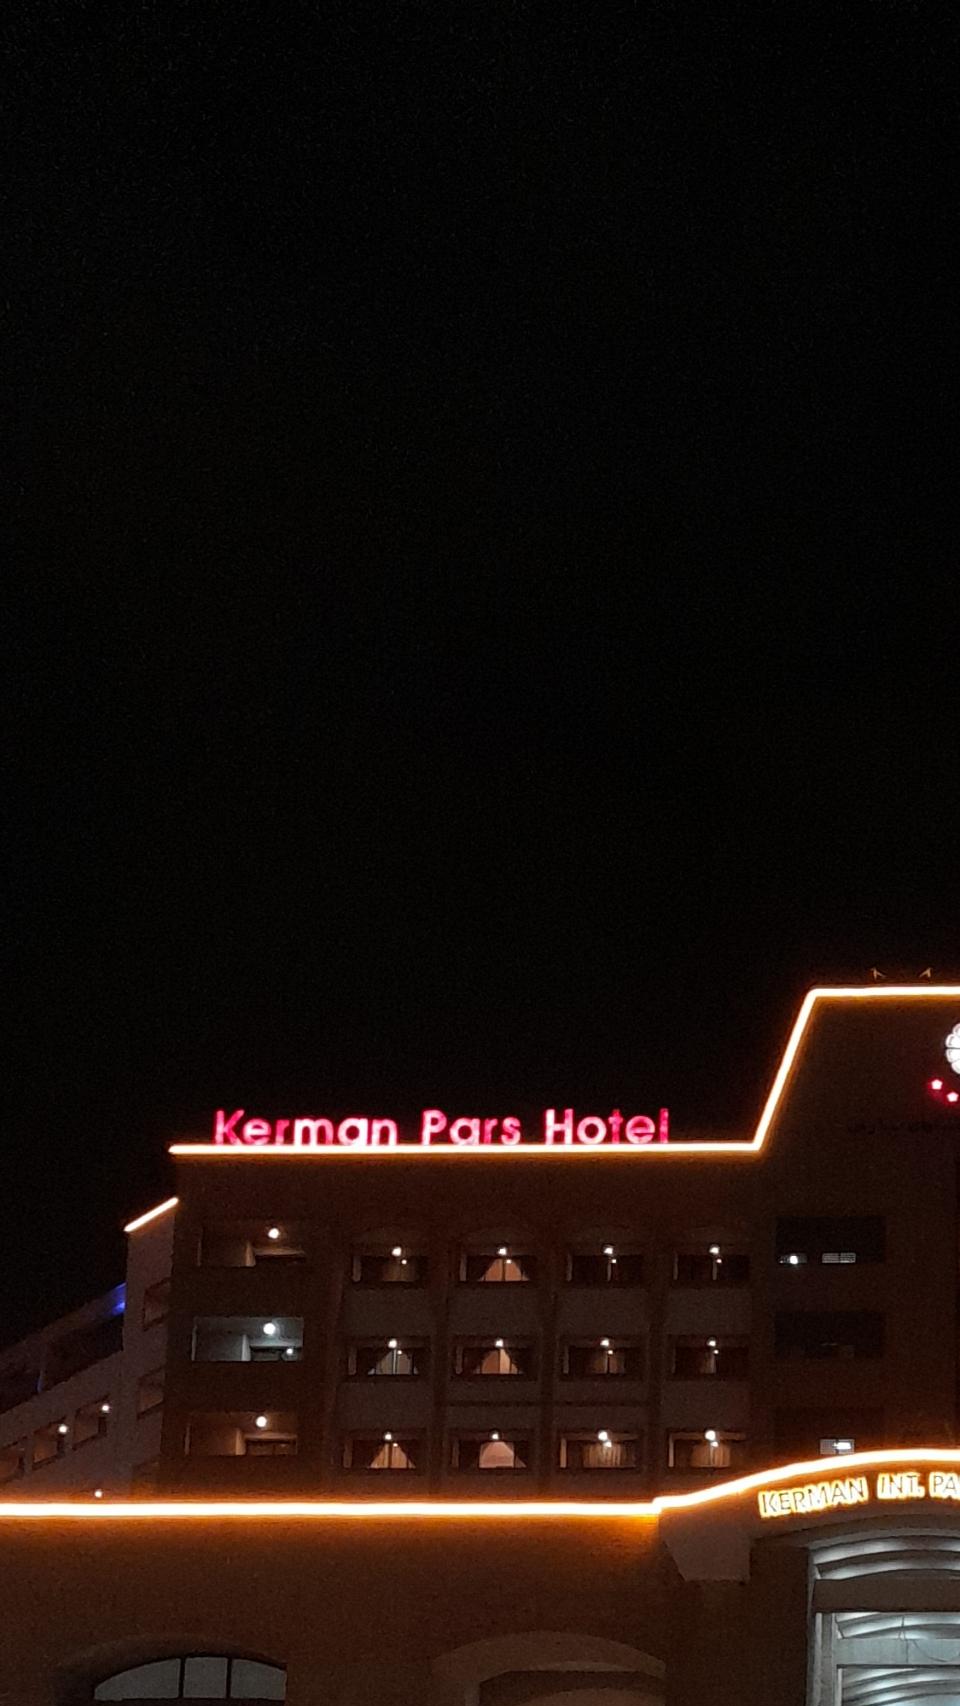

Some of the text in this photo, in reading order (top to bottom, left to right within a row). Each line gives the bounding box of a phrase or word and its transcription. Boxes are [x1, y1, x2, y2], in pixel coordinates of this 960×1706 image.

[213, 1107, 669, 1145] Kerman Pars Hotel
[759, 1478, 867, 1517] KERMAN
[878, 1472, 924, 1497] INT.
